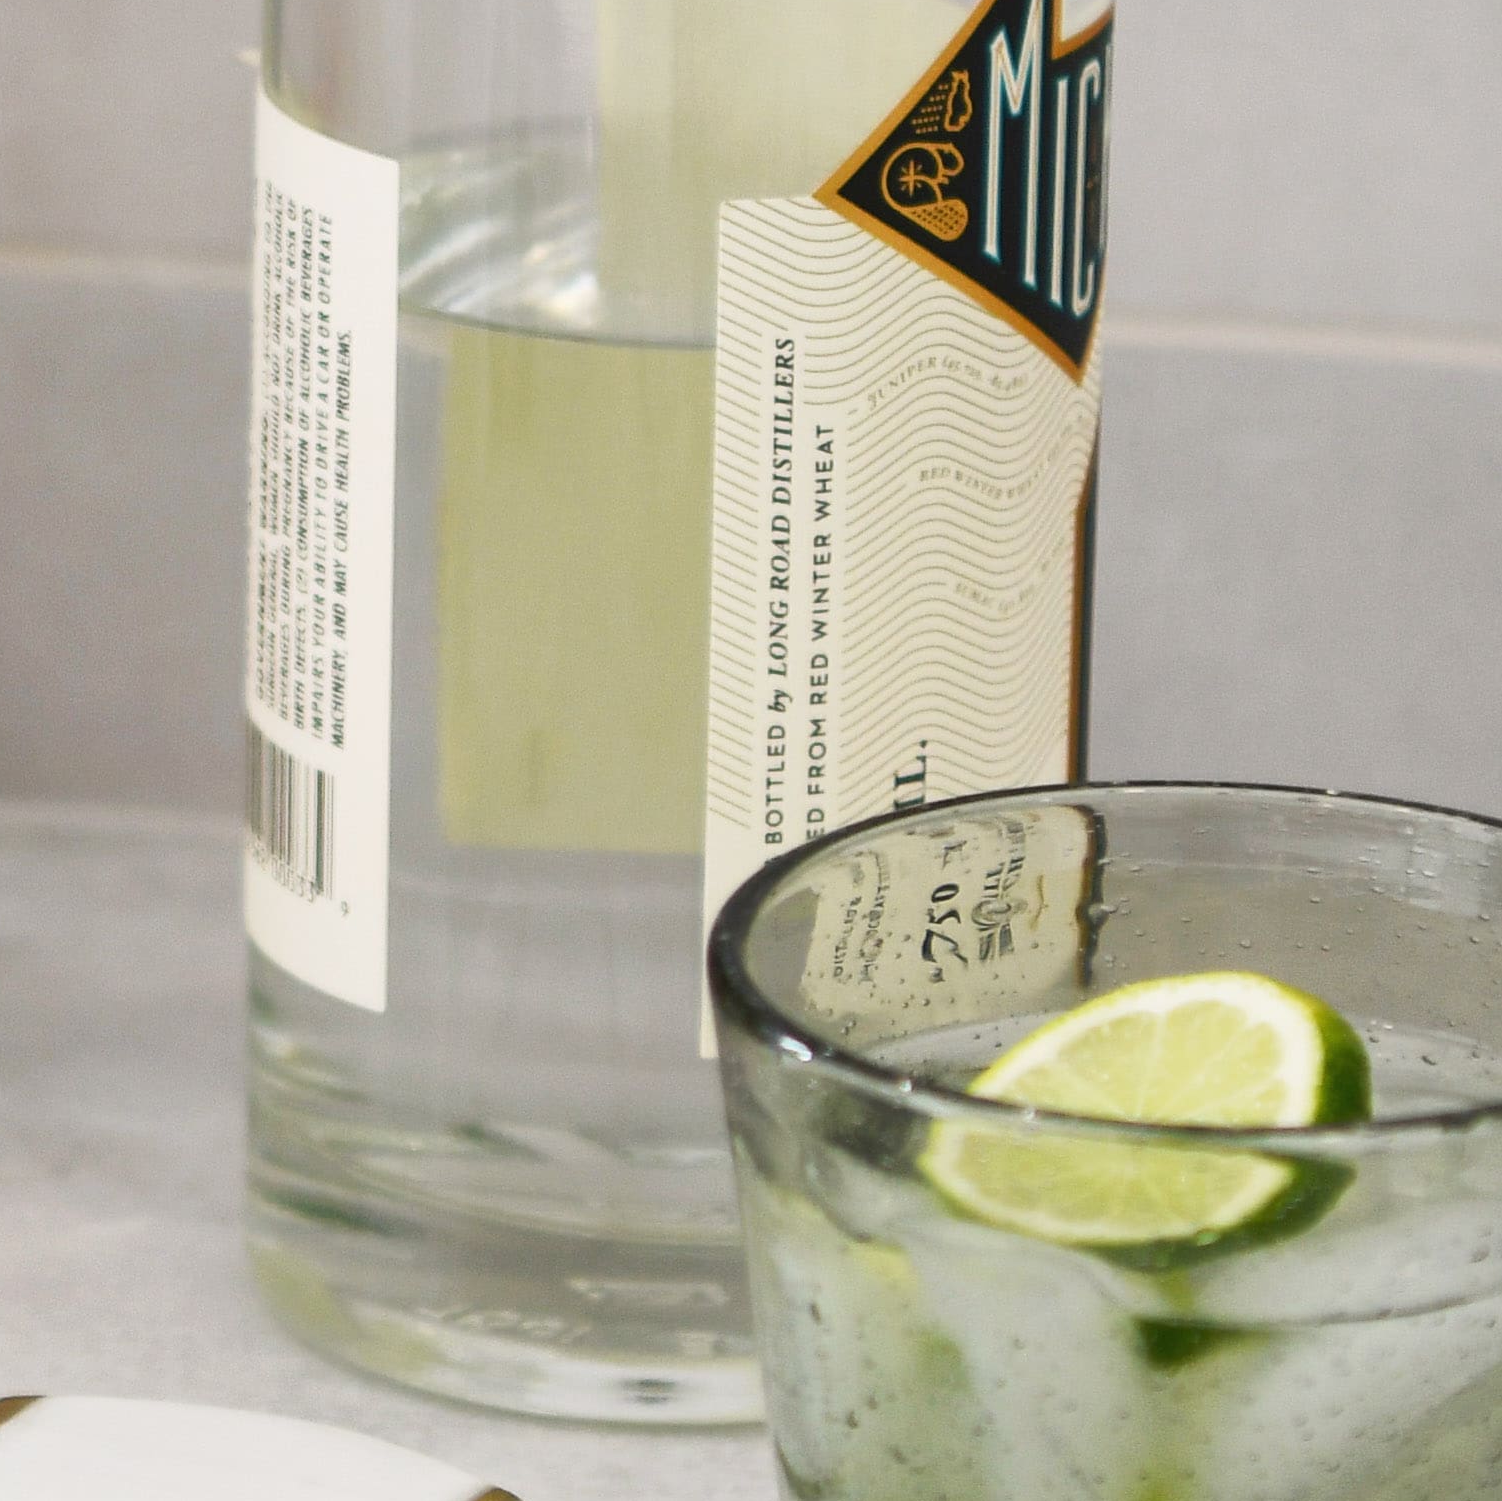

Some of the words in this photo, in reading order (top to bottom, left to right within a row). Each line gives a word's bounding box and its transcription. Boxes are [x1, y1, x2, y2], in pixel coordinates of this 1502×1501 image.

[300, 205, 313, 302] BEVERAGES
[317, 212, 332, 305] OPERATE
[298, 307, 311, 404] ALCOHOLIC
[316, 311, 330, 340] OR
[316, 345, 329, 385] CAR
[316, 392, 329, 404] A
[335, 329, 352, 422] PROBLEMS.
[298, 408, 310, 432] OF
[315, 407, 328, 471] DRIVE
[771, 337, 796, 507] DISTILLERS
[314, 476, 328, 500] TO
[334, 427, 350, 492] HEALTH
[812, 423, 835, 523] WHEAT
[296, 437, 309, 562] CONSUMPTION
[333, 497, 349, 553] CAUSE
[313, 506, 326, 590] ABILITY
[332, 558, 347, 597] MAY
[769, 514, 791, 592] ROAD
[312, 594, 325, 648] YOUR
[331, 601, 347, 641] AND
[810, 532, 832, 643] WINTER
[766, 599, 790, 678] LONG
[293, 679, 305, 731] BIRTH
[311, 653, 324, 740] IMPAIRS
[330, 649, 349, 750] MACHINERY,
[766, 689, 794, 714] by
[808, 653, 829, 706] RED
[764, 724, 786, 845] BOTTLED
[806, 717, 828, 796] FROM
[805, 807, 826, 842] ED
